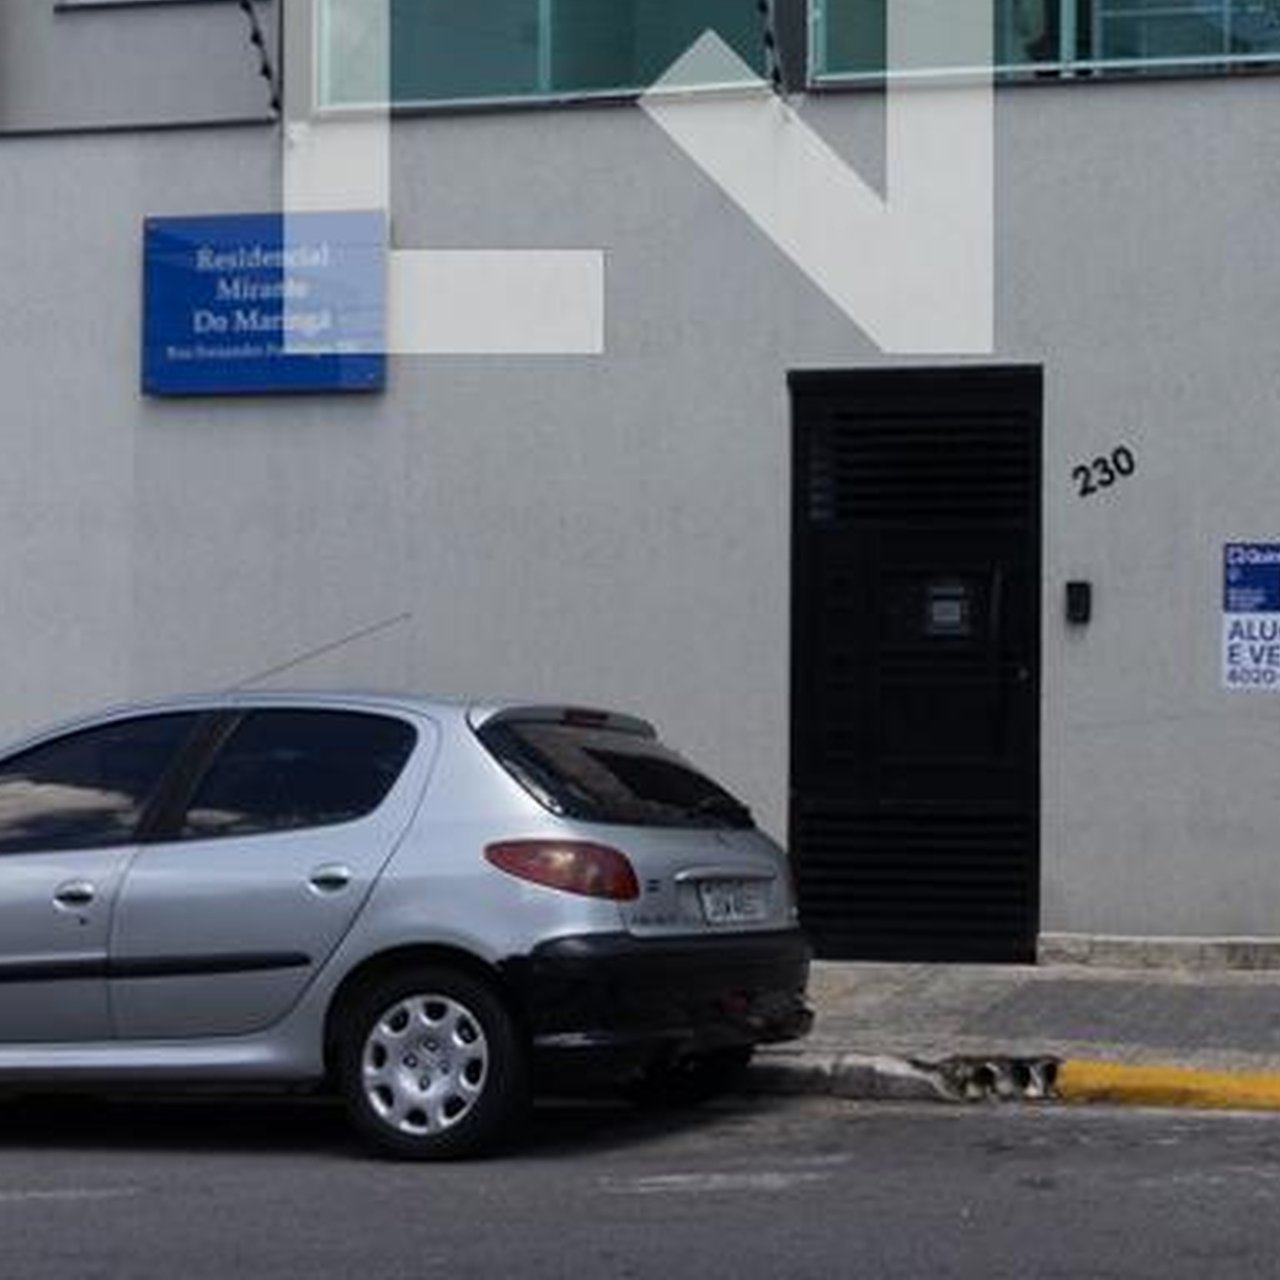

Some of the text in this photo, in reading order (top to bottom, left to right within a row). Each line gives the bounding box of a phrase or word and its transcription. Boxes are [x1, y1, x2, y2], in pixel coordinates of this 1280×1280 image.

[196, 243, 328, 270] Residencial
[193, 310, 228, 334] Do
[1072, 445, 1135, 498] 230
[1227, 643, 1243, 665] E
